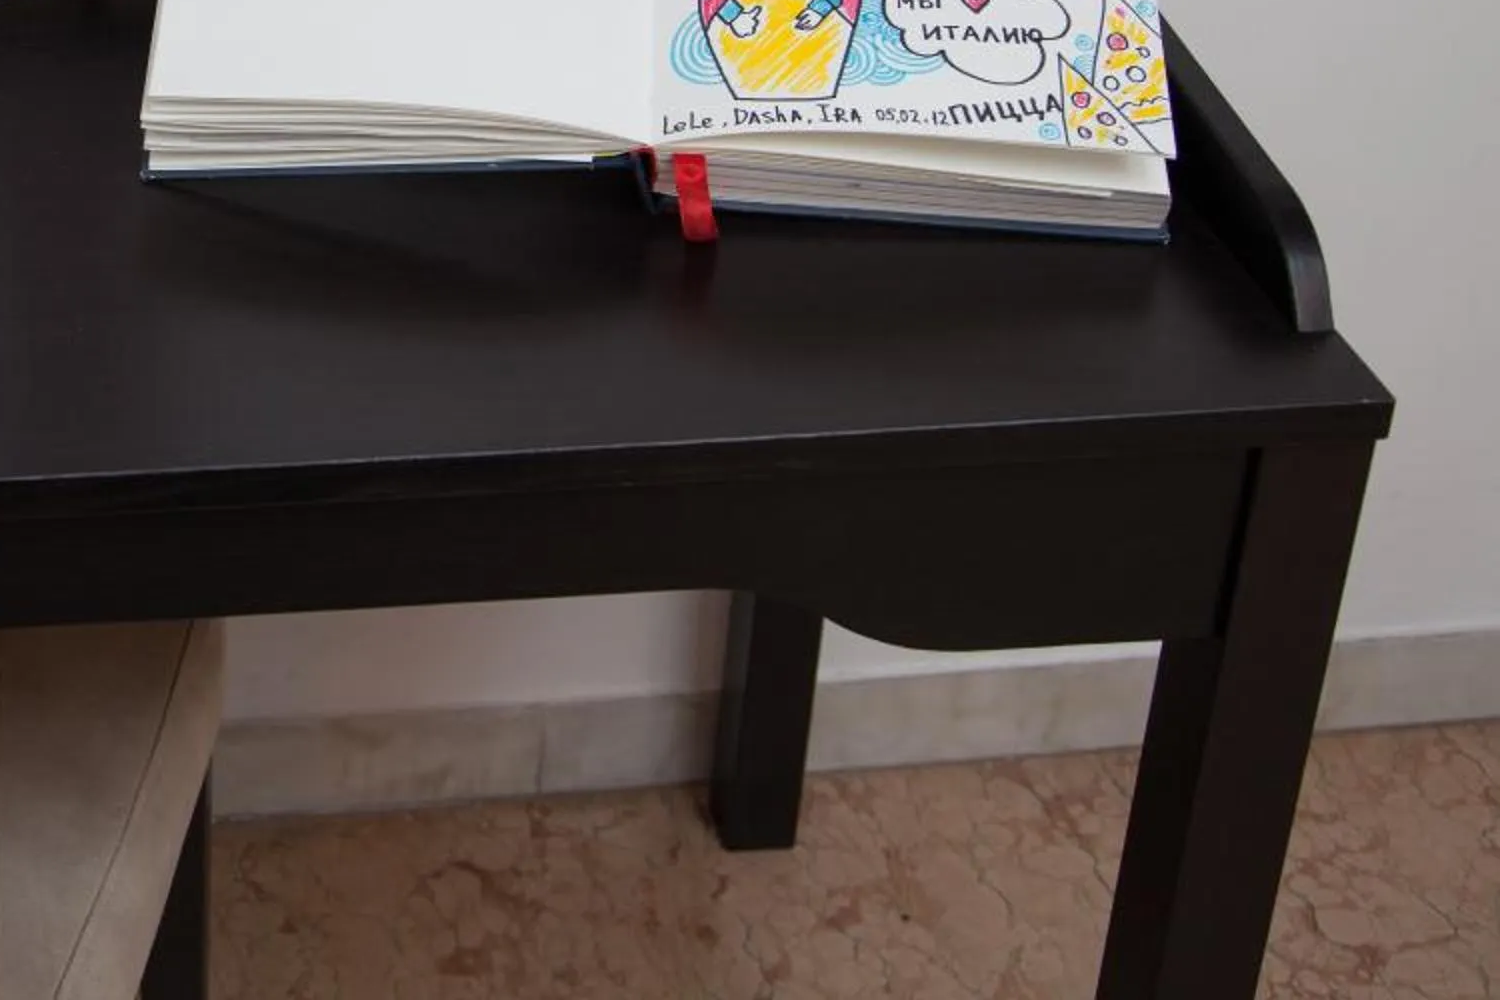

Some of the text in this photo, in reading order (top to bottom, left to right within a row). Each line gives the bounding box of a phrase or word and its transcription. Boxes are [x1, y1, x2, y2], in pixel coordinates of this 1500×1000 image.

[921, 24, 1043, 44] ИТАЛИЮ
[817, 103, 863, 124] IRA
[948, 93, 1064, 125] ПИЦЦА
